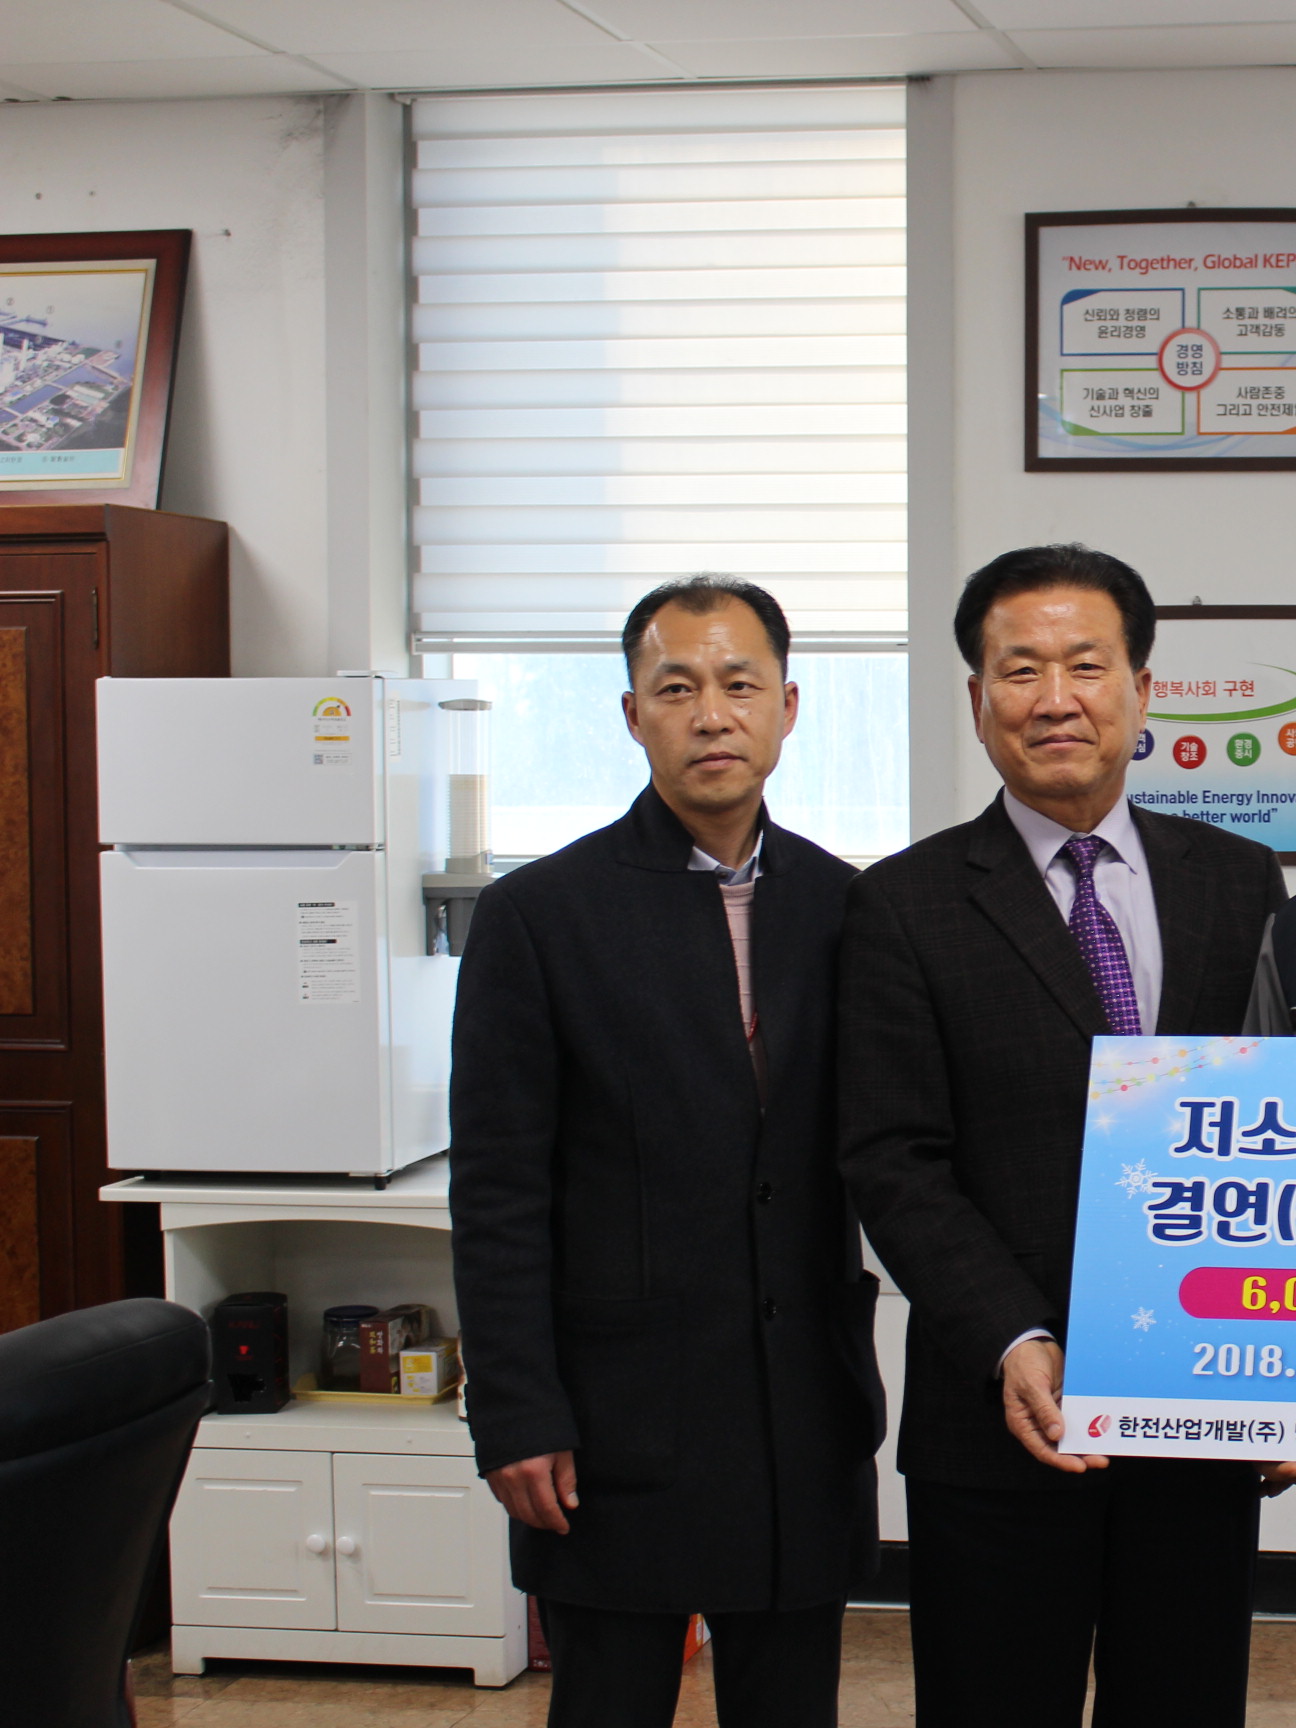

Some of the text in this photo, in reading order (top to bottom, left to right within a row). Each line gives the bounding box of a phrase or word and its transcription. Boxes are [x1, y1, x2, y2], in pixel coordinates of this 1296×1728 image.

[1117, 254, 1199, 275] Together,
[1203, 253, 1258, 269] Global
[1083, 307, 1160, 322] 신뢰와 청렴의
[1222, 306, 1259, 320] 소통과
[1097, 325, 1146, 339] 윤리경영
[1236, 323, 1285, 337] 고객감동
[1176, 344, 1203, 359] 경영
[1176, 361, 1203, 376] 방침
[1082, 386, 1160, 401] 기술과 혁신의
[1236, 386, 1286, 400] 사람존중
[1089, 404, 1154, 418] 신사업 창출
[1216, 403, 1252, 417] 그리고
[1153, 680, 1255, 698] 행복사회 구현
[1180, 742, 1198, 752] 기술
[1234, 739, 1252, 749] 환경
[1180, 752, 1198, 762] 창조
[1234, 749, 1252, 759] 중시
[1202, 790, 1253, 806] Energy
[1193, 1343, 1295, 1377] 2018.
[1118, 1415, 1286, 1445] 한전산업개발(주)
